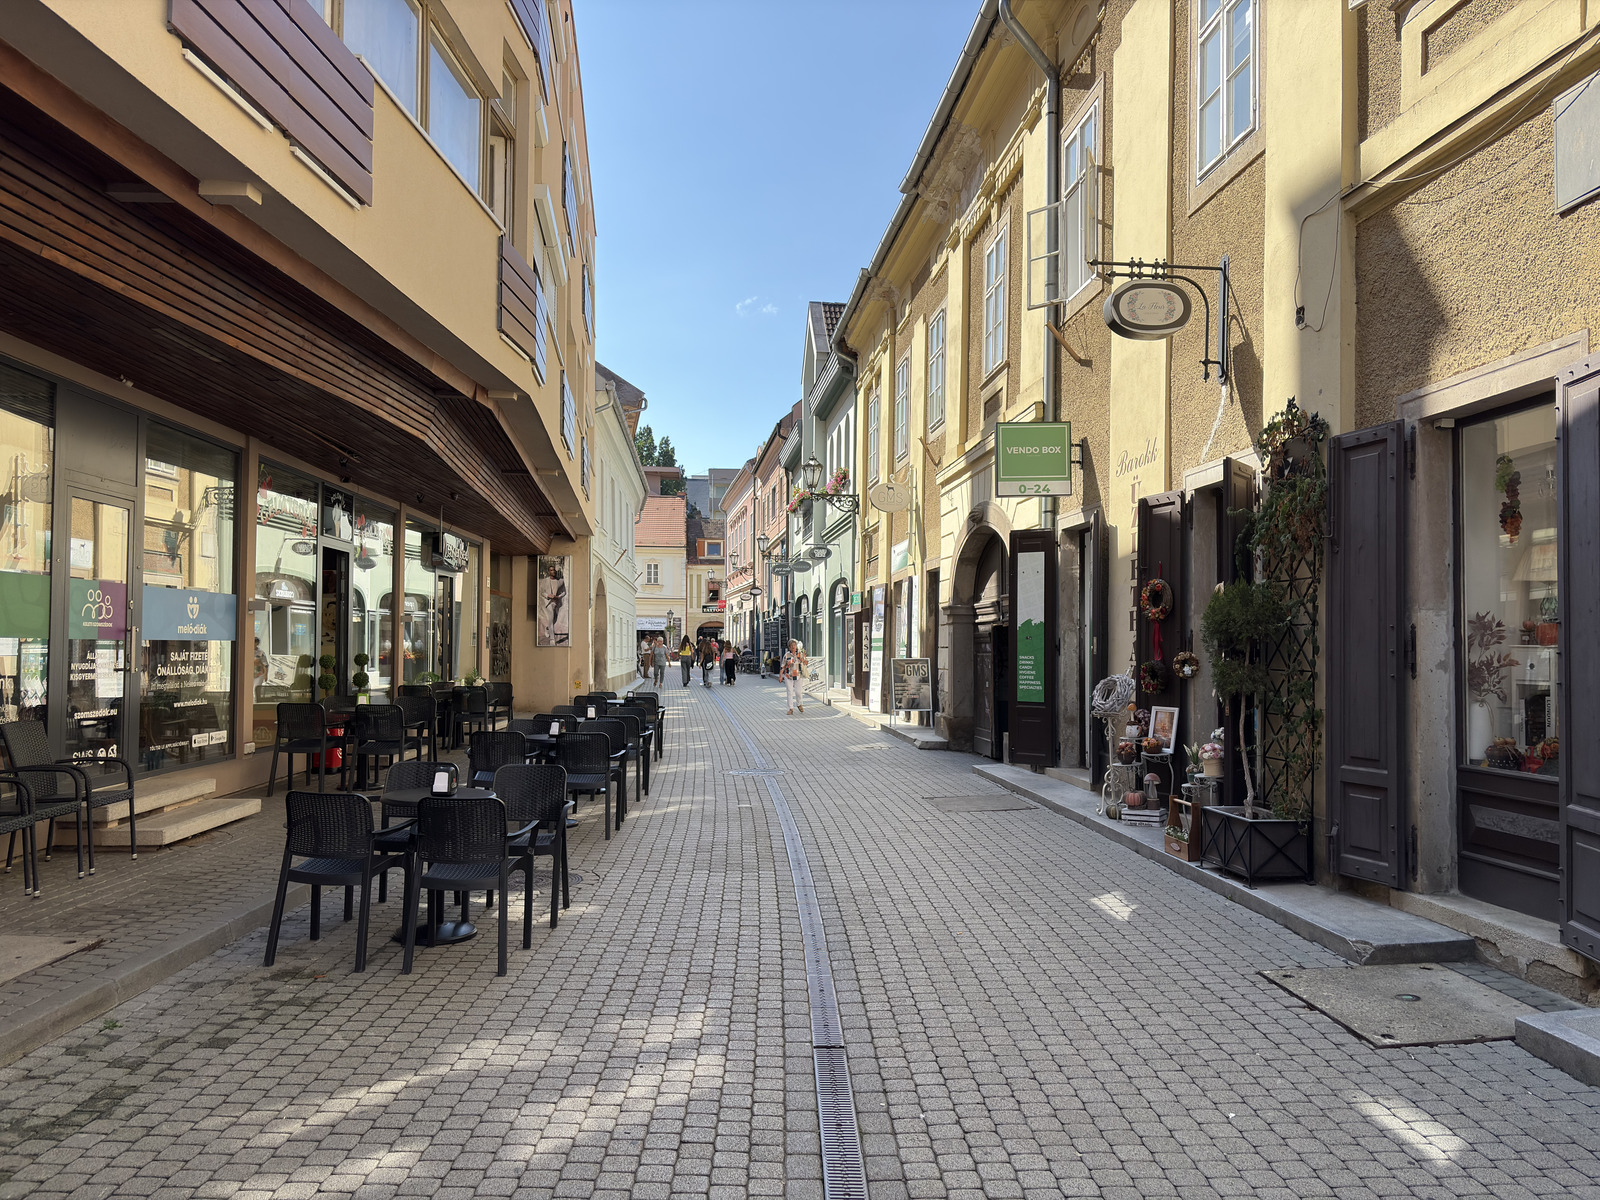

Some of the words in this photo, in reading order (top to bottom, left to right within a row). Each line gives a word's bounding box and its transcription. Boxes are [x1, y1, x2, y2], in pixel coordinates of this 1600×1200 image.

[1148, 302, 1165, 310] Fleur
[1006, 446, 1040, 454] VENDO
[1042, 446, 1062, 454] BOX
[1115, 437, 1159, 478] Barokk
[877, 492, 904, 503] GMS
[170, 649, 190, 662] SAJÁT
[906, 664, 927, 677] GMS
[74, 708, 118, 719] szomszedok.eu
